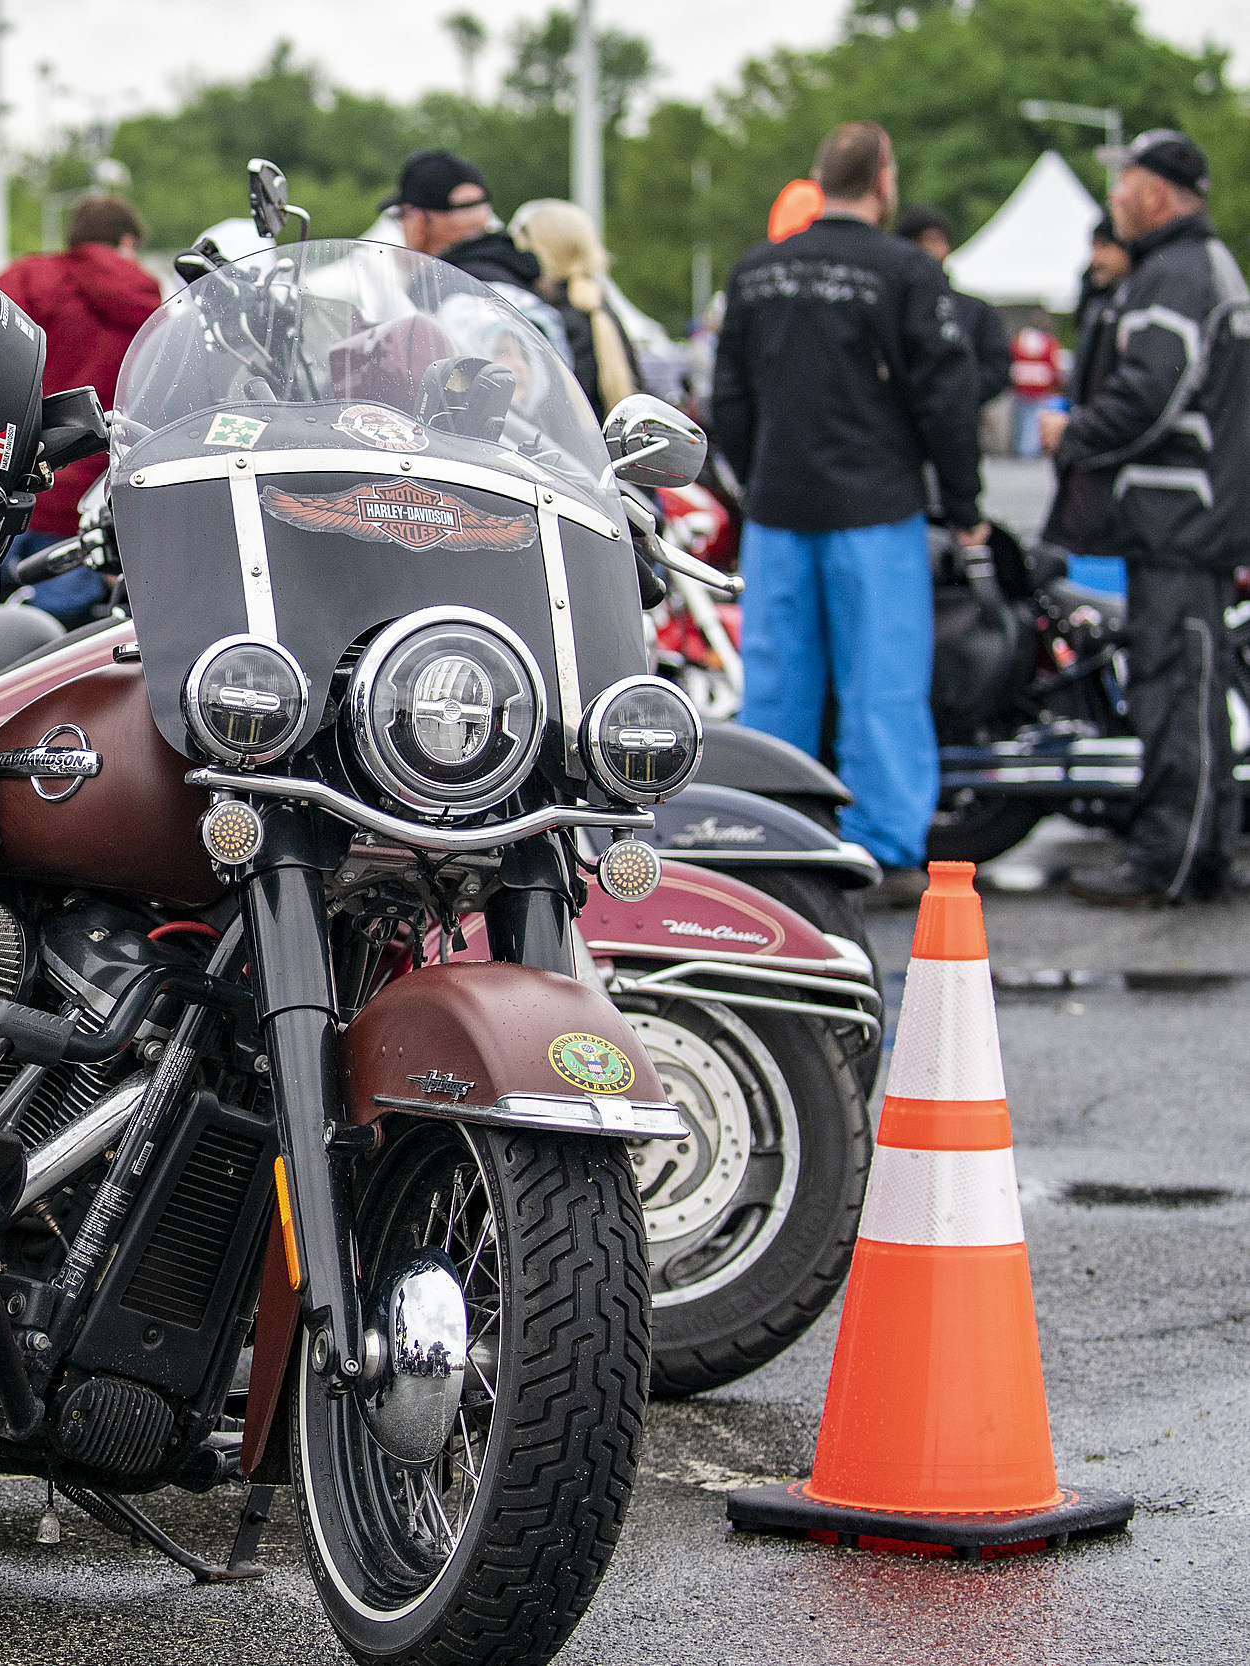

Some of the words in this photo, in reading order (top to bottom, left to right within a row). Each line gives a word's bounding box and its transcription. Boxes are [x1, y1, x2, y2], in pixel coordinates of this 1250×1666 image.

[2, 425, 14, 469] HARLEY-DAVIDSON
[385, 486, 433, 504] MOTOR
[366, 503, 455, 526] HARLEY-DAVIDSON
[390, 523, 437, 542] CYCLES
[553, 1035, 584, 1052] UNITED
[586, 1035, 624, 1058] STATES
[582, 1081, 620, 1091] ARMY
